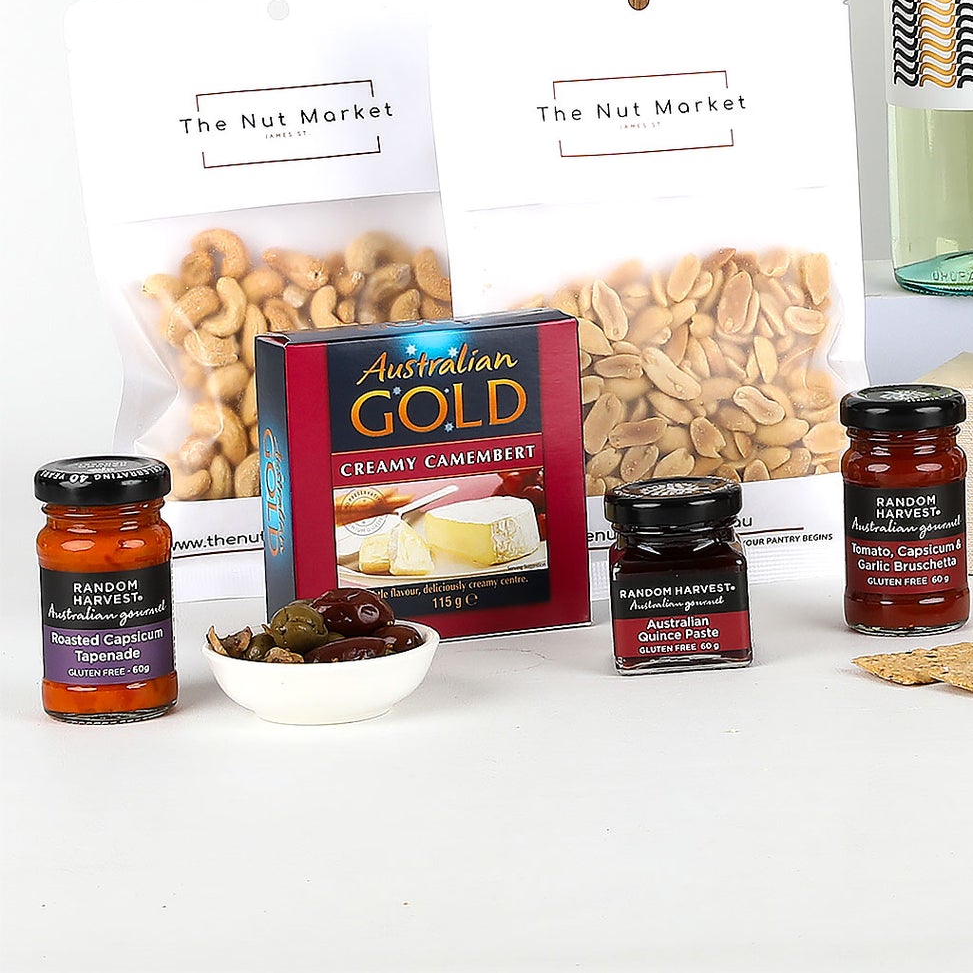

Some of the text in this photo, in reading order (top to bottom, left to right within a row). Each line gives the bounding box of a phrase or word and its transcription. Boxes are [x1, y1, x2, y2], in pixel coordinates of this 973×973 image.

[537, 95, 747, 122] The Nut Market
[179, 102, 393, 134] The Nut Market
[265, 131, 293, 139] JAMES
[355, 343, 518, 386] Australian
[350, 379, 528, 438] GOLD
[340, 444, 536, 478] CREAMY CAMEMBERT
[69, 473, 89, 484] 40
[93, 465, 164, 481] CELEBRATING
[263, 427, 280, 556] GOLD
[877, 494, 936, 507] RANDOM
[876, 507, 937, 519] HARVEST
[851, 516, 918, 532] Australian
[766, 536, 801, 545] PANTRY
[802, 533, 833, 542] BEGINS
[851, 538, 962, 558] Tomato, Capsicum &
[858, 557, 957, 572] Garlic Bruschetta
[73, 579, 138, 594] RANDOM
[390, 587, 421, 598] flavour,
[422, 580, 467, 594] deliciously
[468, 579, 498, 590] creamy
[500, 575, 529, 586] centre.
[867, 575, 950, 586] GLUTEN FREE 60 g
[73, 592, 139, 606] HARVEST
[619, 583, 732, 599] RANDOM HARVEST
[432, 595, 453, 609] 115
[454, 597, 463, 609] g
[629, 595, 725, 612] Australian gourmet
[48, 603, 119, 621] Australian
[646, 616, 710, 630] Australian
[51, 628, 164, 647] Roasted Capsicum
[637, 628, 719, 643] Quince Paste
[74, 648, 141, 664] Tapenade
[639, 642, 720, 654] GLUTEN FREE 60 g
[68, 668, 102, 678] GLUTEN
[102, 667, 126, 677] FREE
[132, 664, 150, 675] 60g
